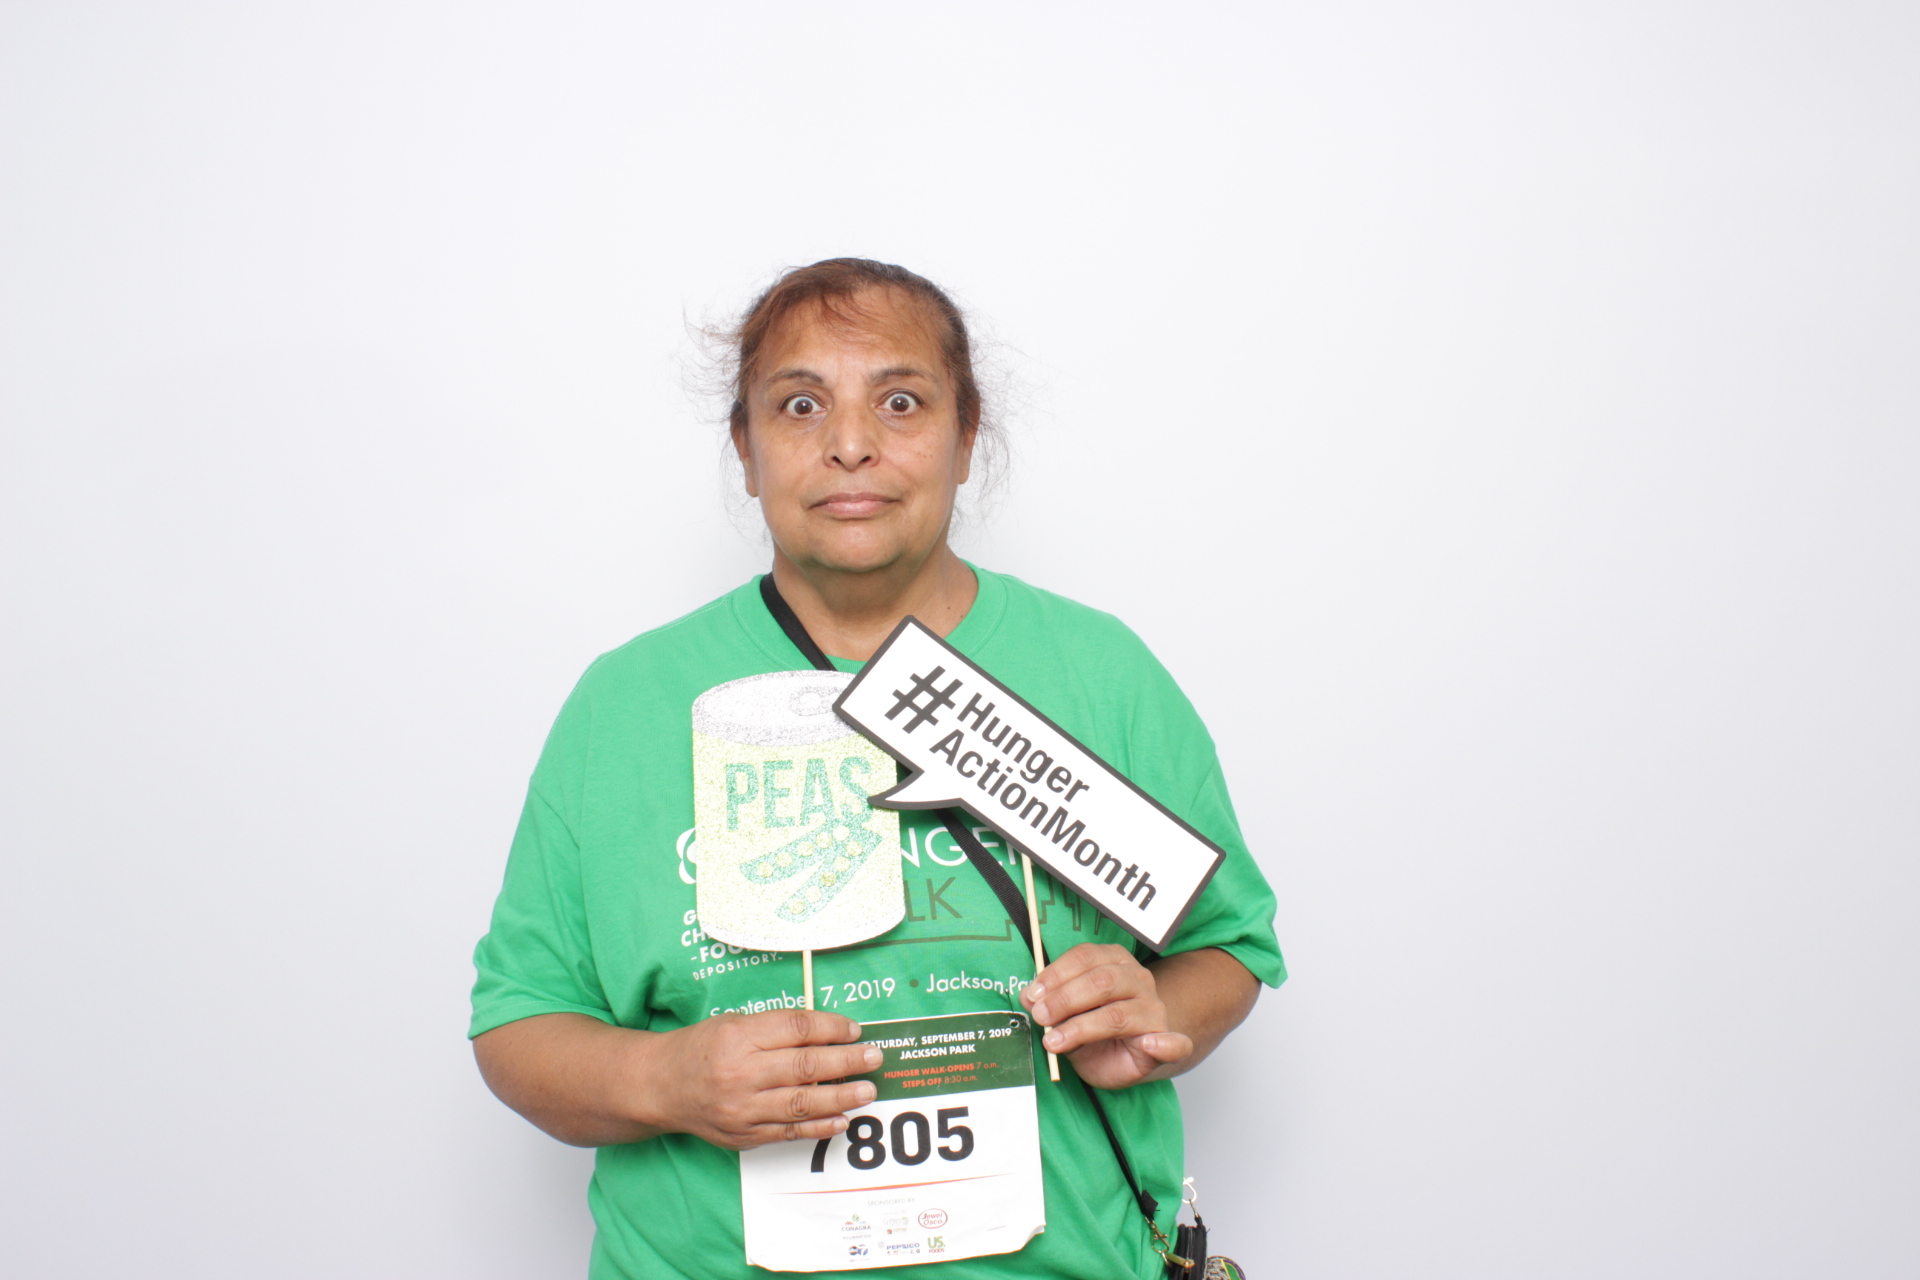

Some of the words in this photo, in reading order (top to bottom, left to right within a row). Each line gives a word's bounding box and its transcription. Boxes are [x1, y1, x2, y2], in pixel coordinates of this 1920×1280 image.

[725, 756, 873, 830] PEAS
[929, 729, 1157, 911] ActionMonth
[903, 876, 963, 922] LK
[692, 952, 778, 980] DEPOSITORY
[820, 986, 837, 1008] 7,
[844, 977, 896, 1003] 2019
[926, 971, 1004, 994] Jackson
[1009, 972, 1036, 995] Pa
[921, 1031, 975, 1045] SEPTEMBER
[977, 1030, 986, 1040] 7,
[989, 1028, 1012, 1038] 2019
[900, 1047, 947, 1060] JACKSON
[950, 1044, 976, 1054] PARK
[884, 1069, 919, 1078] HUNGER
[921, 1066, 945, 1075] WALK
[947, 1063, 974, 1073] OPENS
[902, 1079, 925, 1088] STEPS
[927, 1077, 942, 1086] OFF
[944, 1075, 961, 1083] 8:30
[867, 1198, 906, 1206] SPONSORED
[922, 1212, 943, 1220] Jewel
